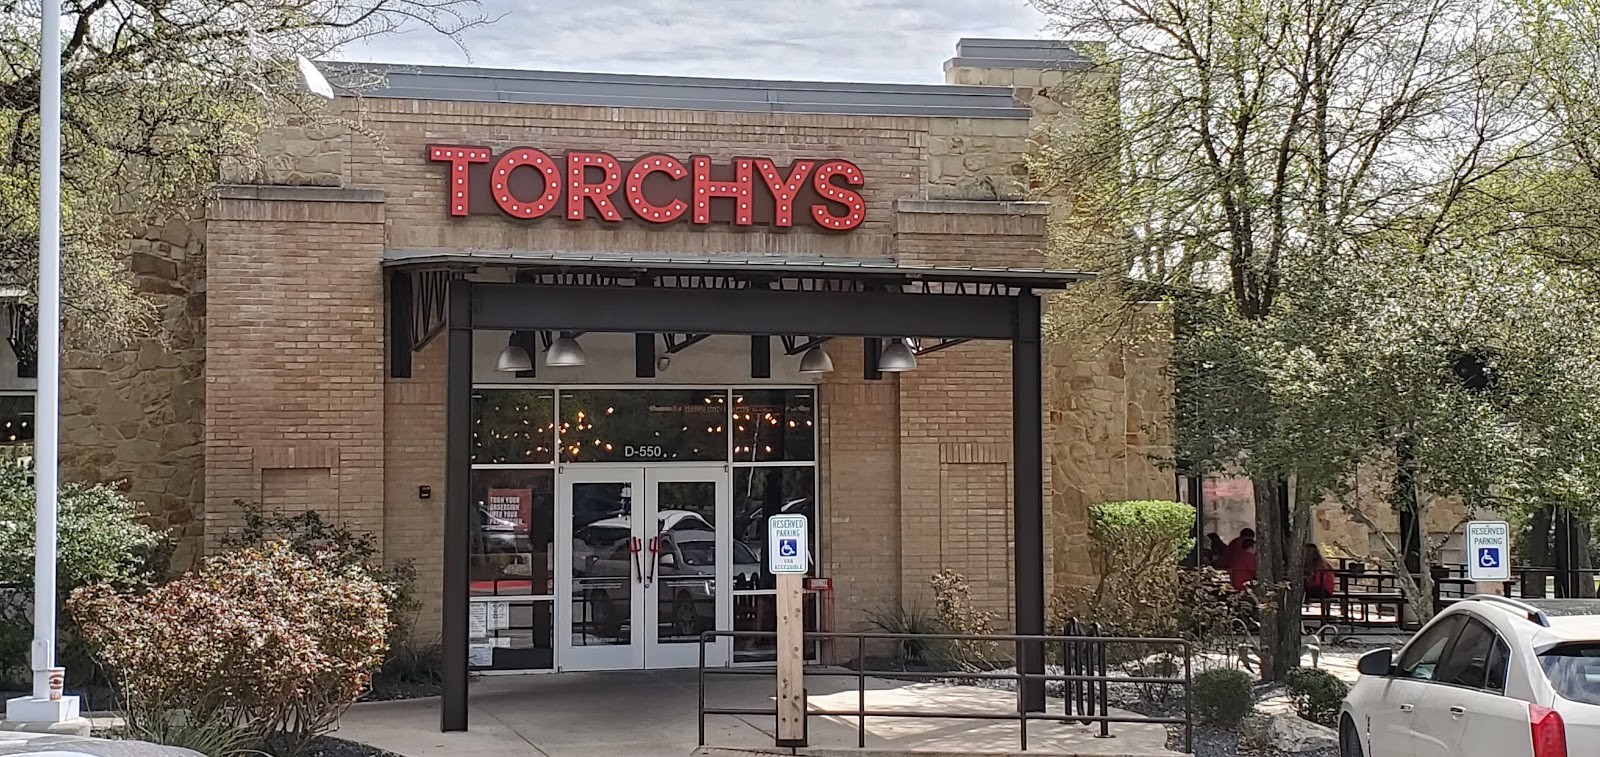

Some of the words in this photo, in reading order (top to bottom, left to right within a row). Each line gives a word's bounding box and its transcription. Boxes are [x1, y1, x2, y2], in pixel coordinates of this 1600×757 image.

[429, 146, 866, 231] TORCHYS
[624, 445, 662, 457] D-550
[772, 519, 804, 529] RESERVED
[776, 529, 801, 537] PARKING
[1471, 527, 1505, 536] RESERVED
[1474, 537, 1503, 545] PARKING
